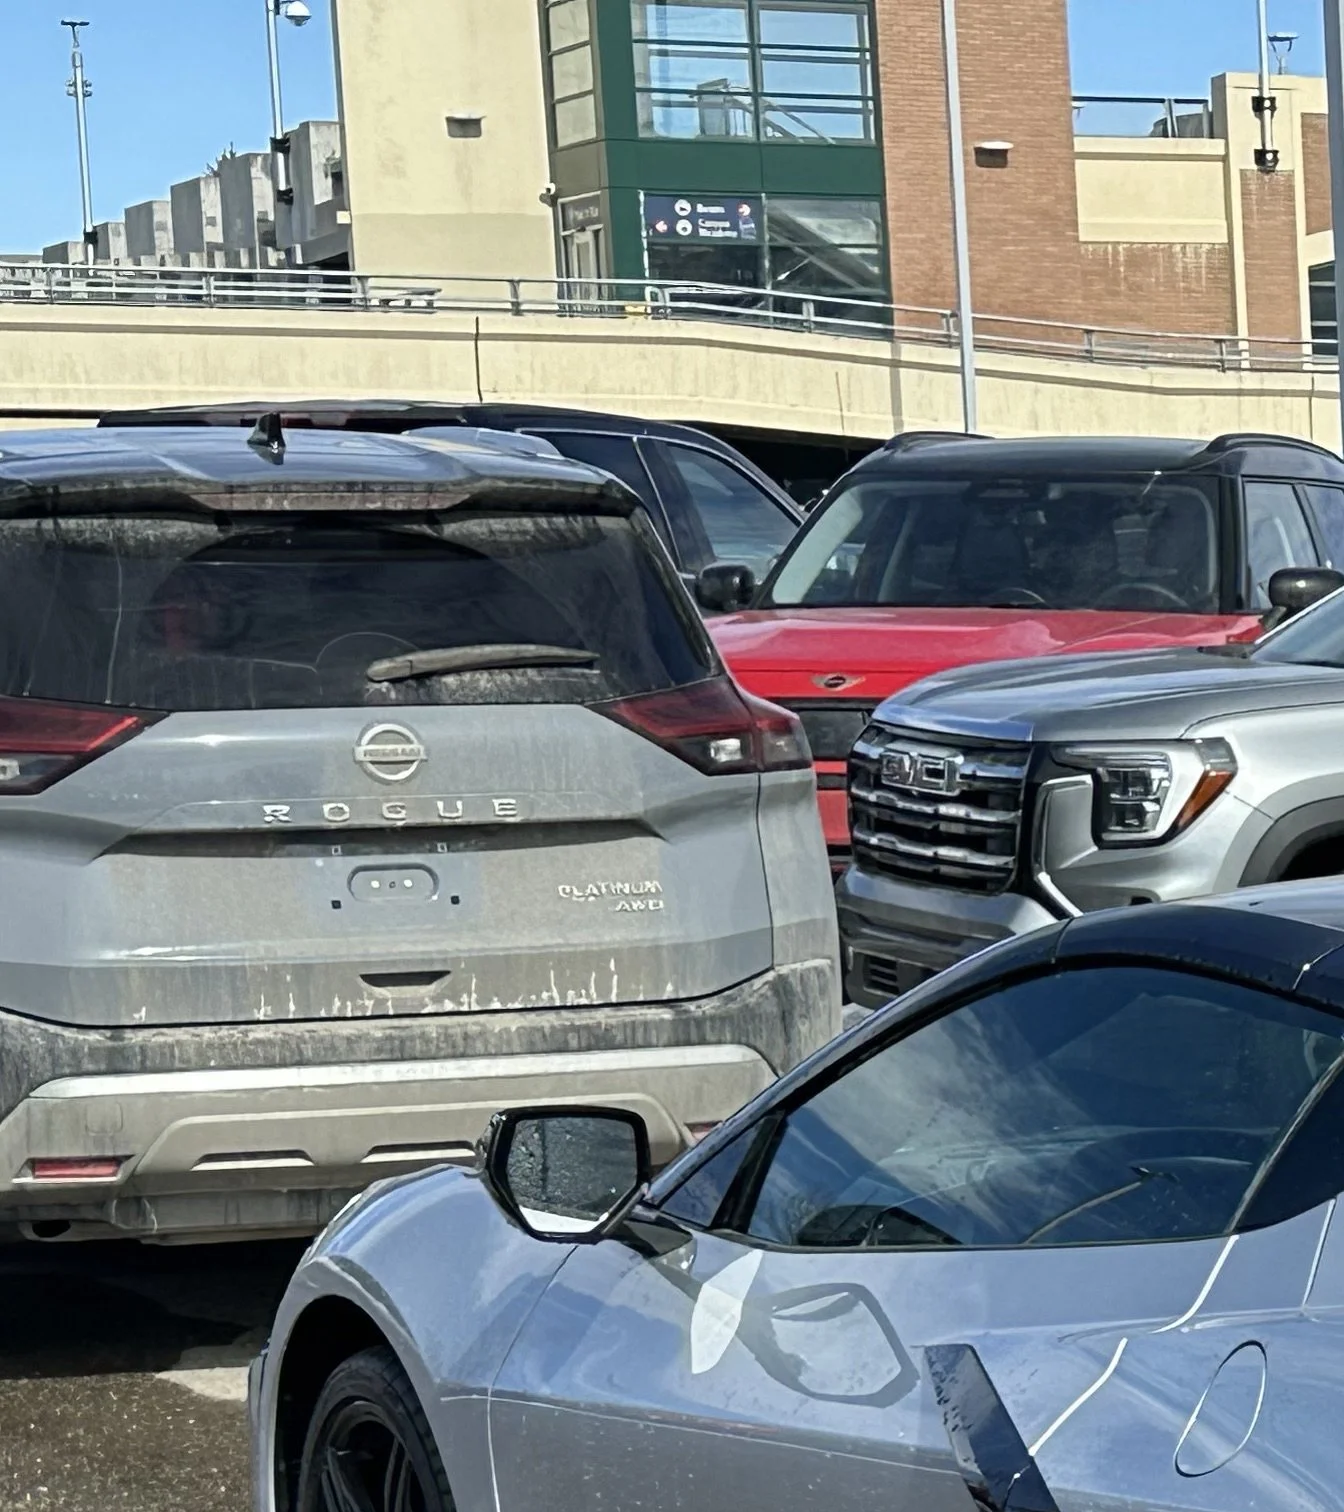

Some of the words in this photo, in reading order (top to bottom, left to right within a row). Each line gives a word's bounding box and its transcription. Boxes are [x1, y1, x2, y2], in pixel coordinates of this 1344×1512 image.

[263, 798, 518, 823] ROGUE
[558, 880, 663, 898] PLATINUM
[615, 899, 664, 912] AWD
